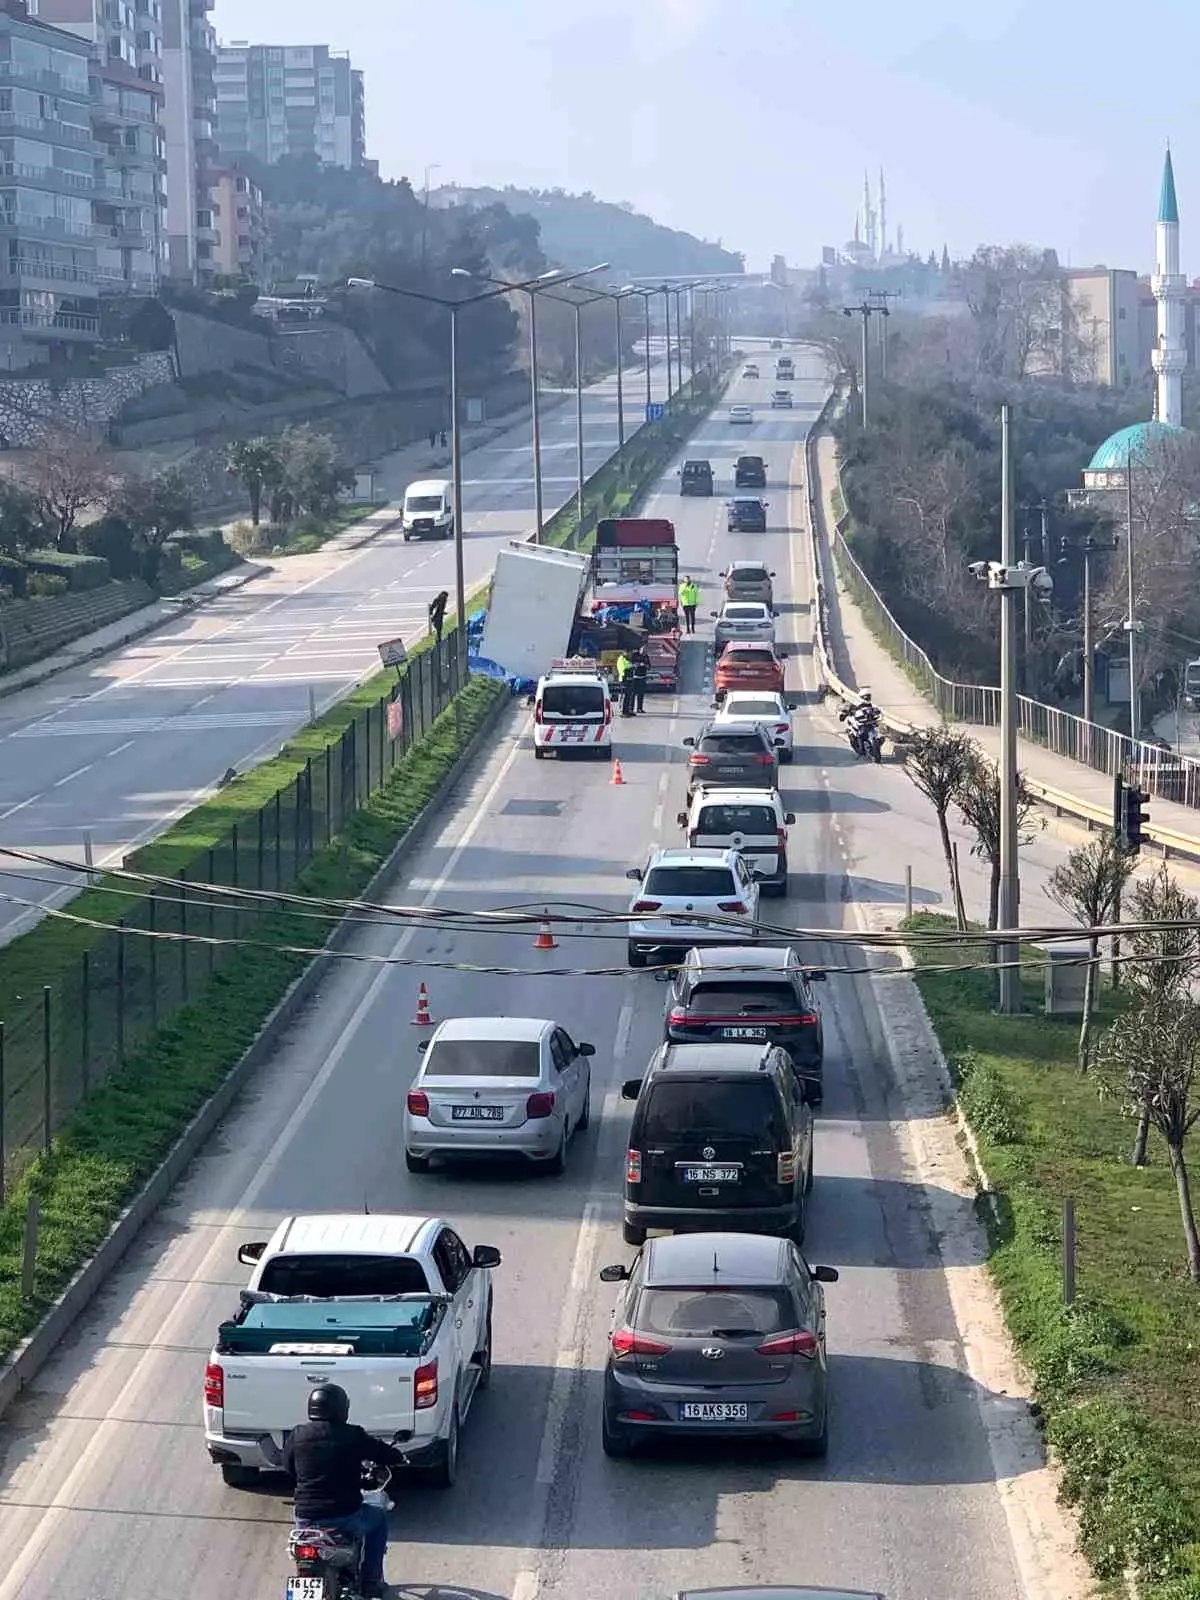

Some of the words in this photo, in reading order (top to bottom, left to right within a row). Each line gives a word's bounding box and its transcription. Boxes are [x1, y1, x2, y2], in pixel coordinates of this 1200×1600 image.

[702, 1169, 716, 1180] NS
[688, 1405, 700, 1416] 16
[703, 1404, 724, 1416] AKS
[725, 1404, 746, 1416] 356
[289, 1579, 301, 1589] 16
[303, 1579, 321, 1589] LCZ
[303, 1589, 315, 1599] 72
